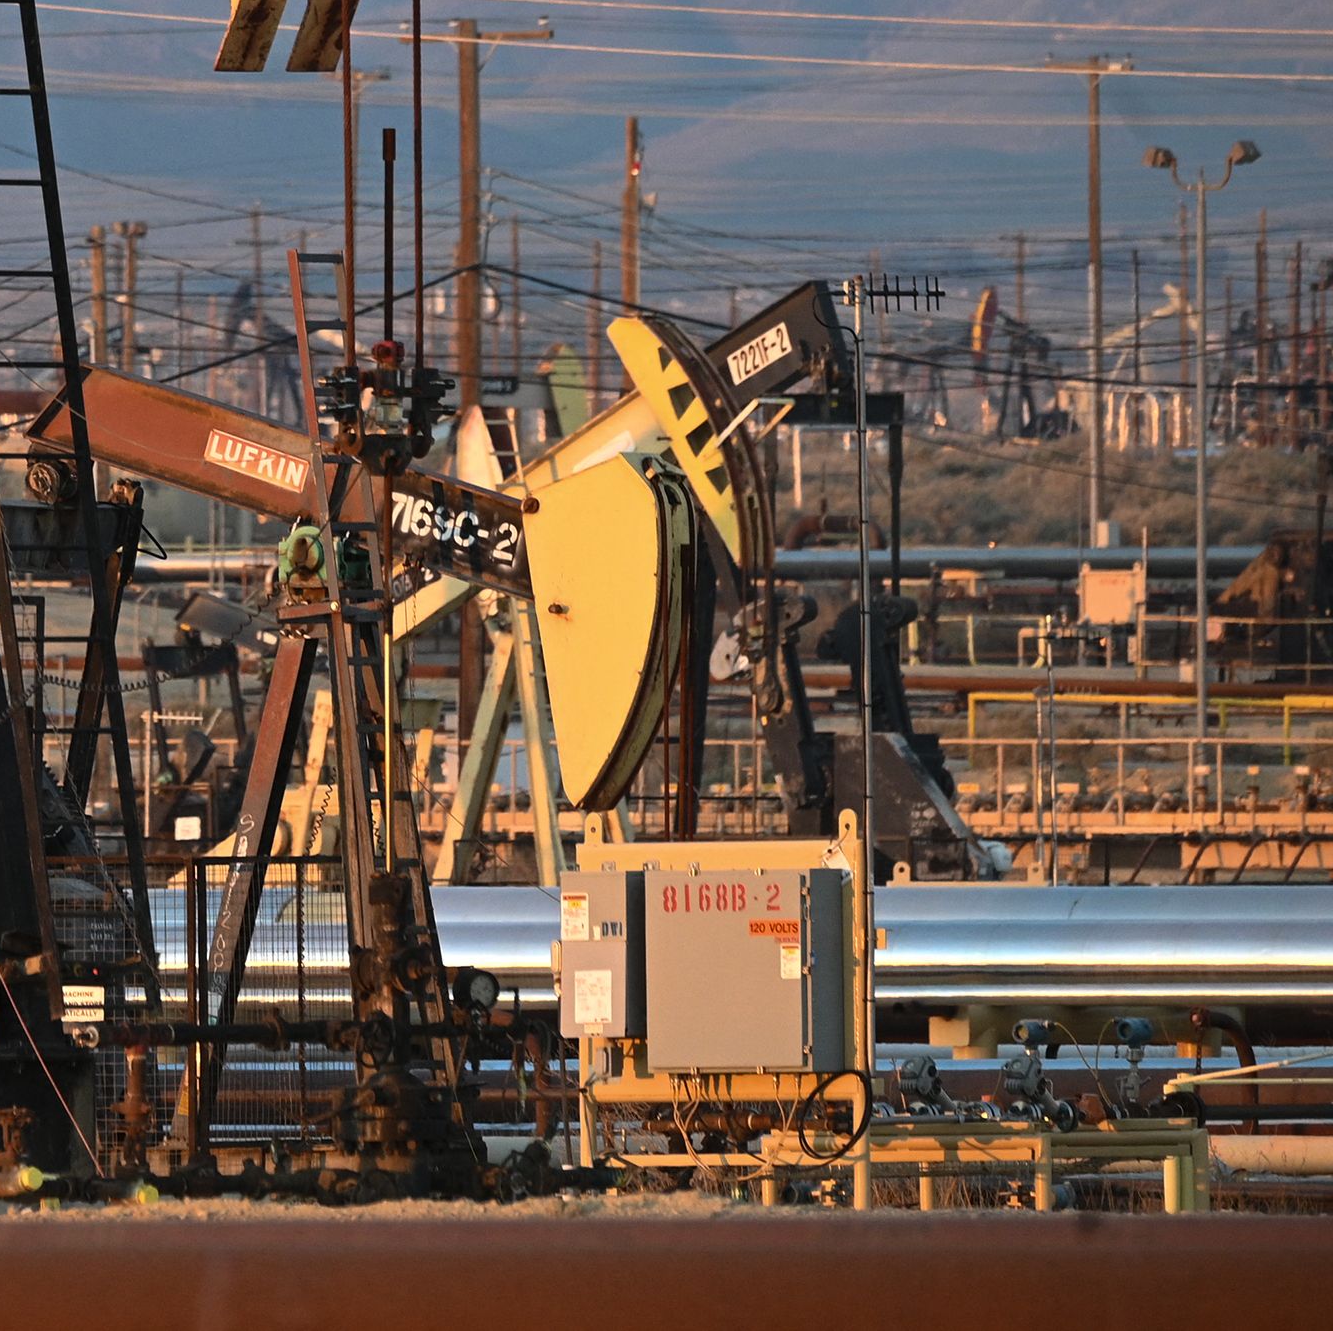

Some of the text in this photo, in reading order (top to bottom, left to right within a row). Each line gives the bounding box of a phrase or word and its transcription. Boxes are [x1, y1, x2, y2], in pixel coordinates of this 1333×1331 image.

[732, 328, 787, 380] 7221F-2
[209, 435, 304, 487] LUFKIN
[391, 491, 519, 562] 7169C-2
[749, 922, 799, 934] 120 VOLTS
